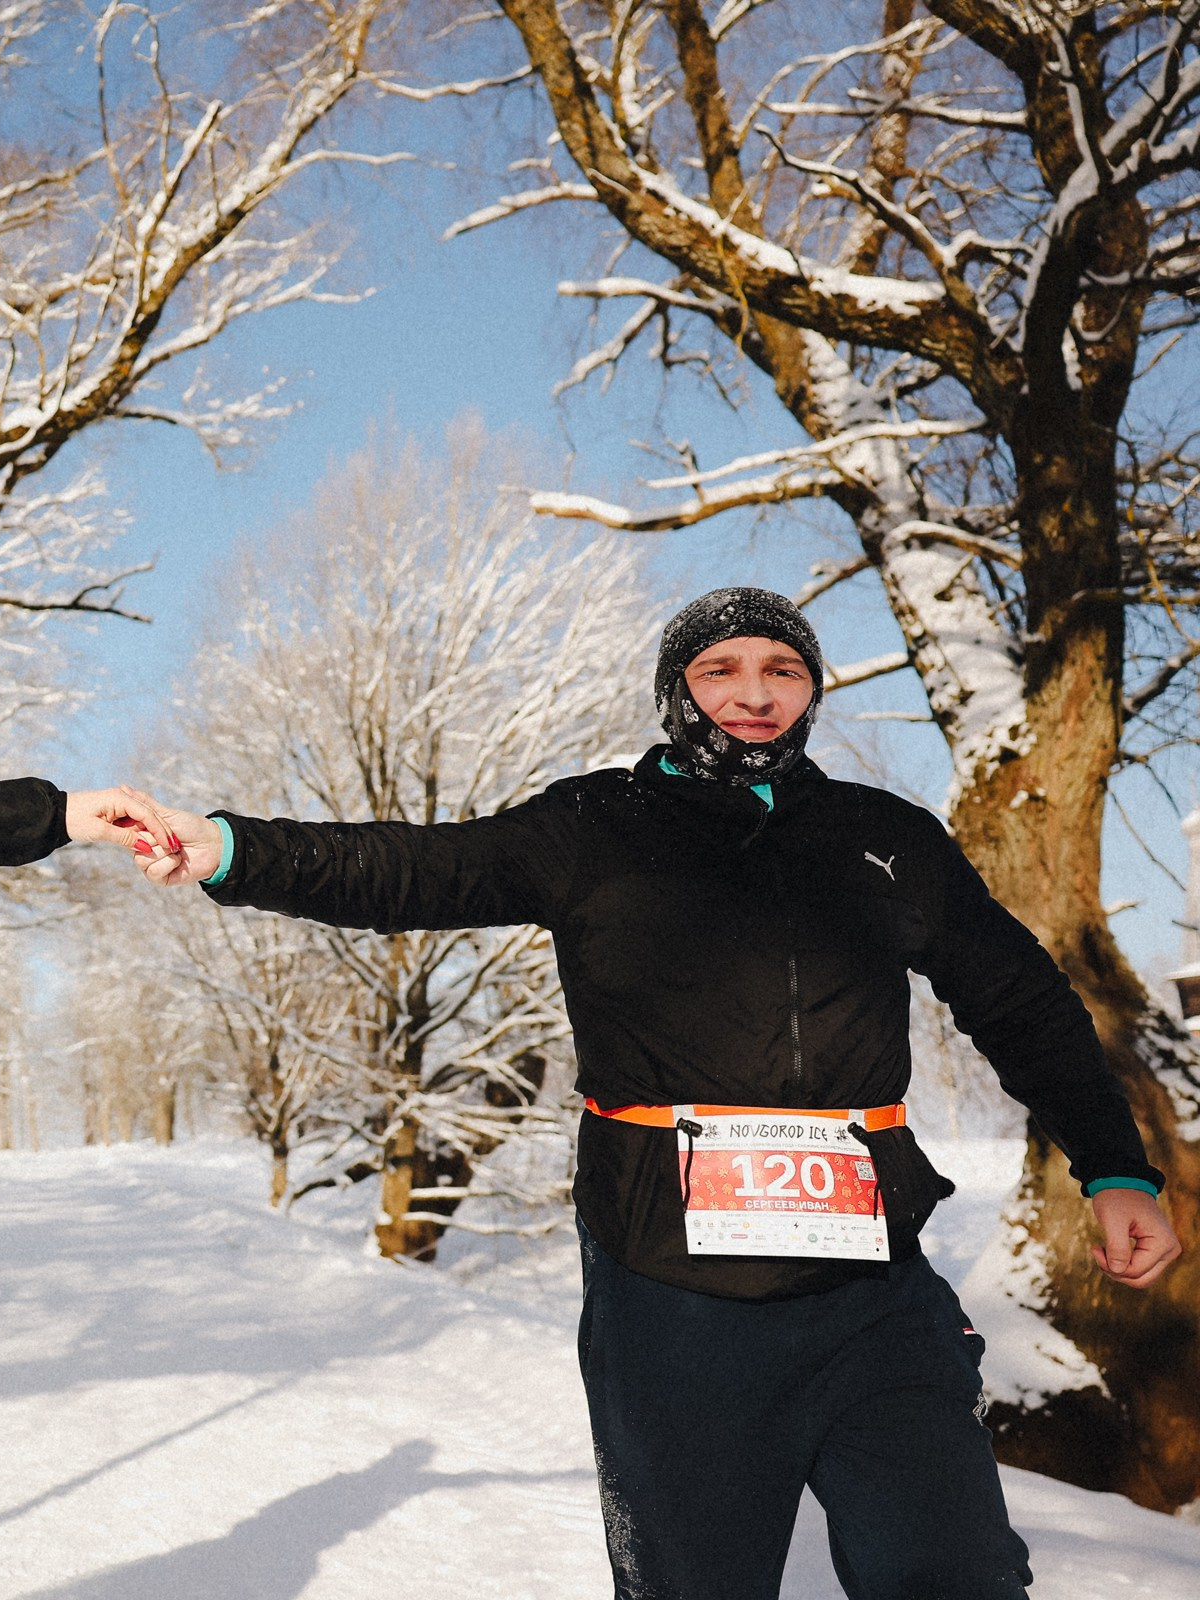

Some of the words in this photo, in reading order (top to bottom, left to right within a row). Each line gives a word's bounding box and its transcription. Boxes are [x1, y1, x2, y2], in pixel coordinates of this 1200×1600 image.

[730, 1124, 804, 1138] NOVGOROD
[809, 1126, 828, 1142] ICE
[731, 1154, 835, 1199] 120
[745, 1199, 796, 1210] СЕРГЕЕВ
[799, 1201, 830, 1211] ИВАН
